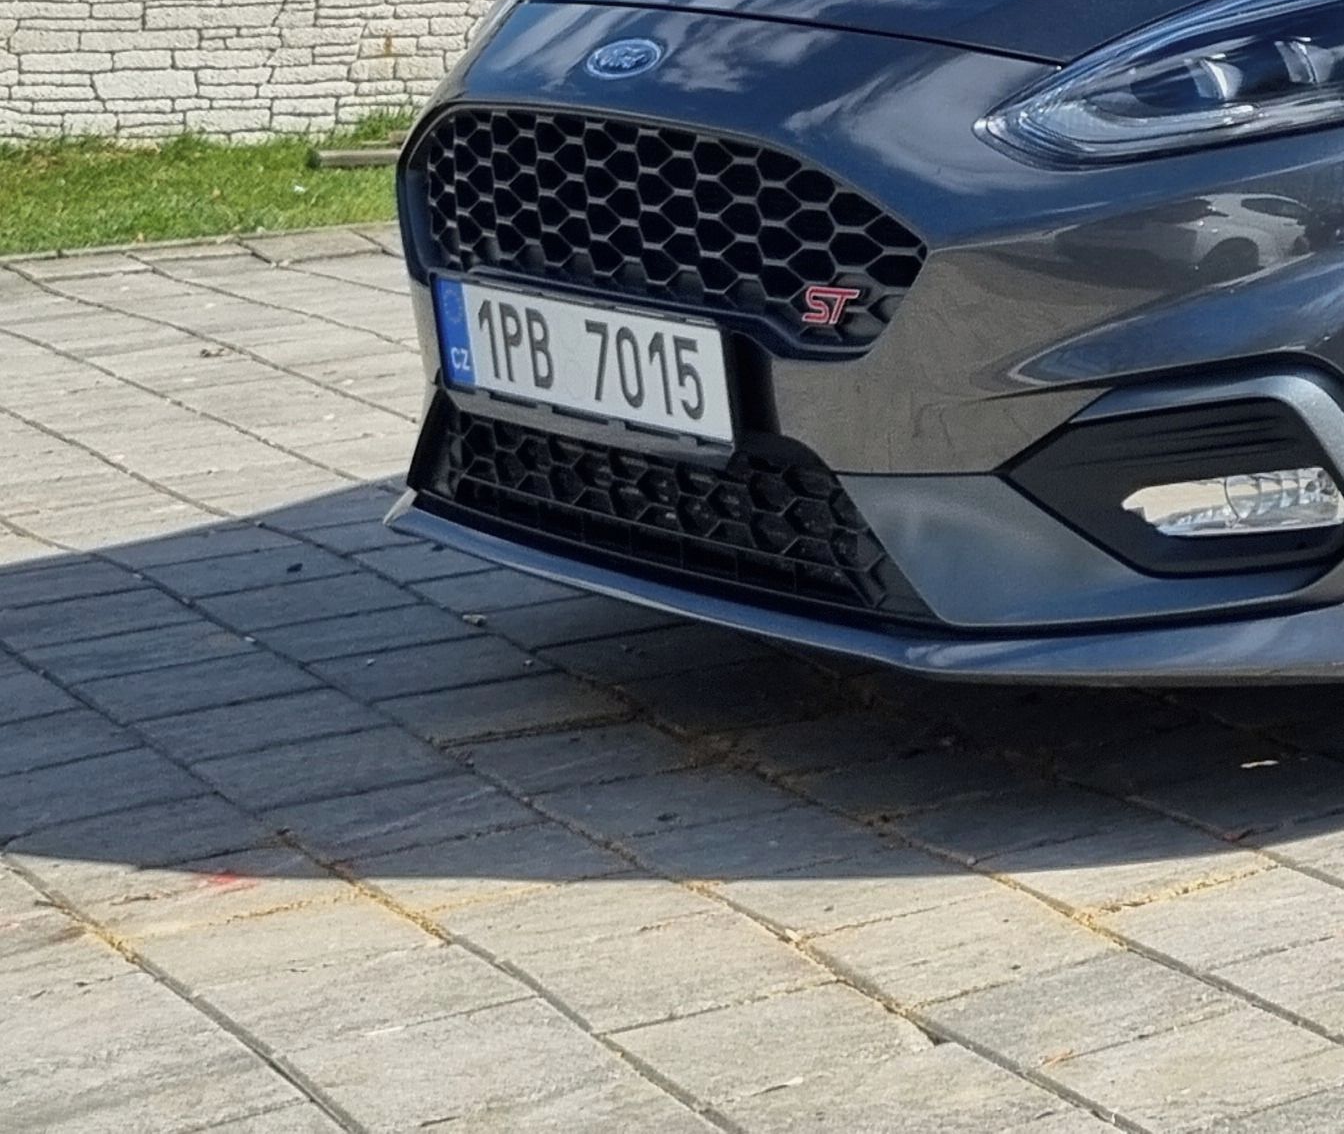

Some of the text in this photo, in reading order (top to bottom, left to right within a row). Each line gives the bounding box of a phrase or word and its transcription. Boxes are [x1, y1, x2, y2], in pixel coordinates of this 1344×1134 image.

[802, 286, 860, 324] ST
[450, 347, 471, 371] CZ
[478, 299, 705, 420] 1PB 7015
